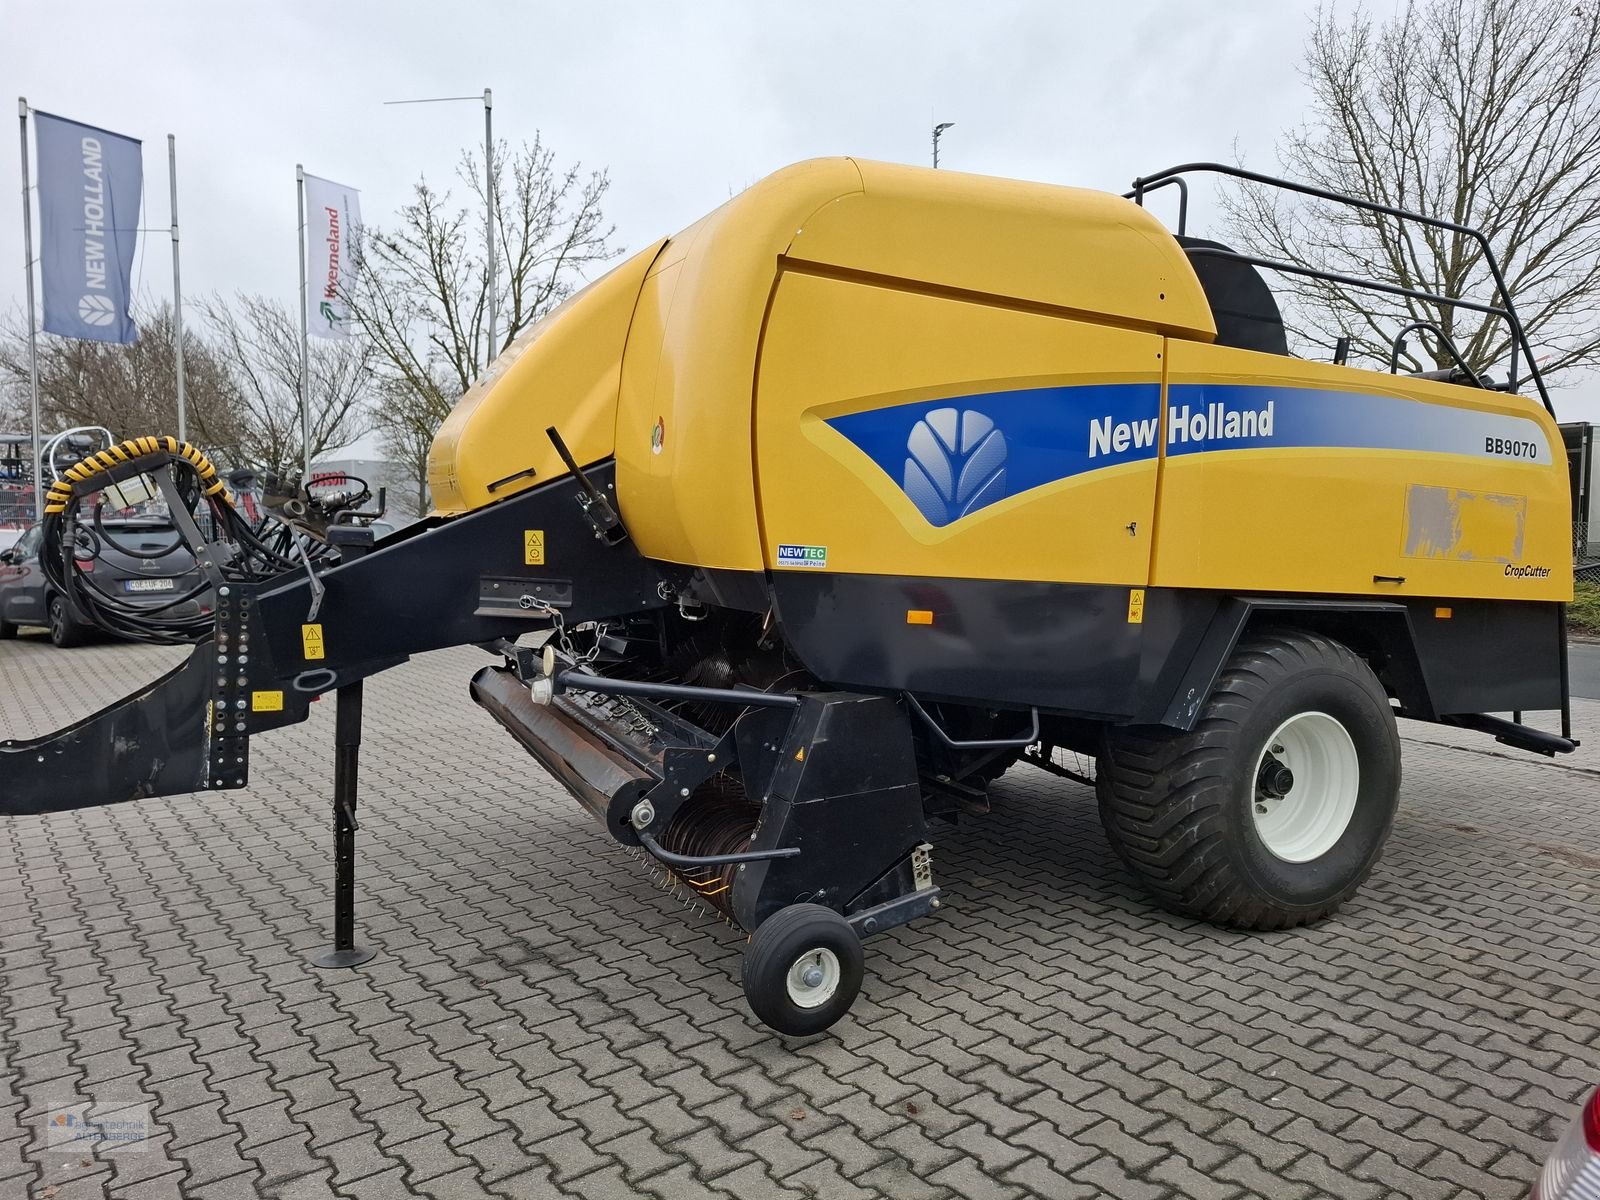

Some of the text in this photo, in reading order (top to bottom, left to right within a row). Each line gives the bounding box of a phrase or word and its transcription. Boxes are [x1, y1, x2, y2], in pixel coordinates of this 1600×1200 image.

[81, 137, 106, 289] NEW HOLLAND
[324, 206, 340, 300] Kverneland
[1088, 400, 1275, 459] New Holland
[1485, 436, 1537, 459] BB9070
[779, 547, 825, 558] NEWTEC
[1504, 564, 1551, 579] CropCutter
